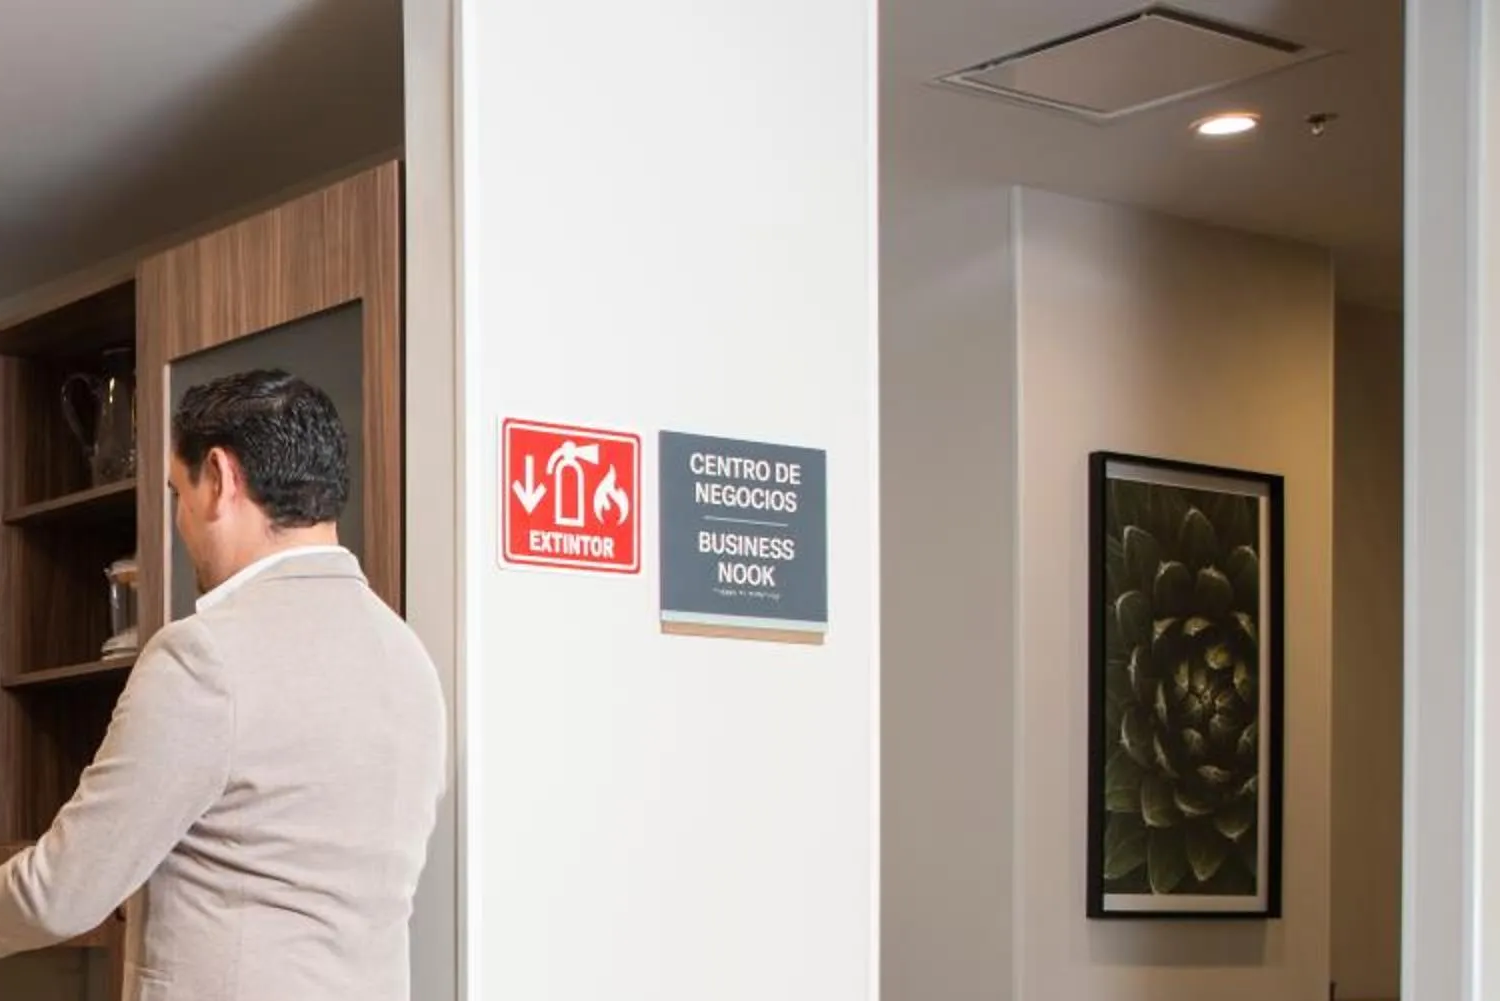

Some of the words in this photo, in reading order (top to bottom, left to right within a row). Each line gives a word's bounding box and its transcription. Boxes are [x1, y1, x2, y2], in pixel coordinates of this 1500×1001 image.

[689, 452, 771, 482] CENTRO
[775, 463, 802, 485] DE
[695, 481, 798, 514] NEGOCIOS
[529, 530, 615, 558] EXTINTOR
[698, 531, 796, 561] BUSINESS
[717, 562, 776, 587] NOOK
